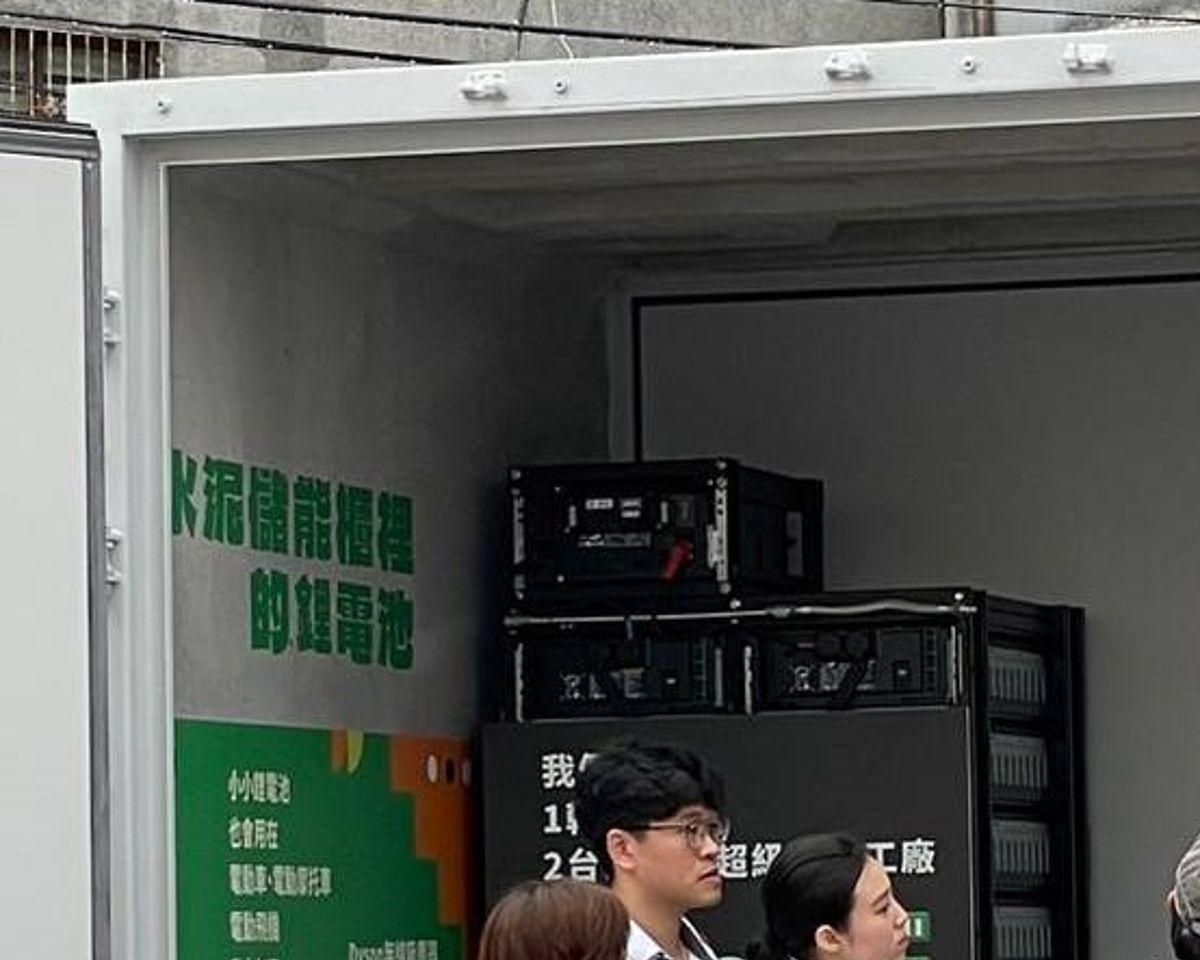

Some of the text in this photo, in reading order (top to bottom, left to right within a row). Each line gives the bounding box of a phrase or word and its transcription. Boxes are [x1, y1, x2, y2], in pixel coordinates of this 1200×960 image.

[250, 568, 415, 671] 的鋰電池
[865, 837, 936, 874] 工廠
